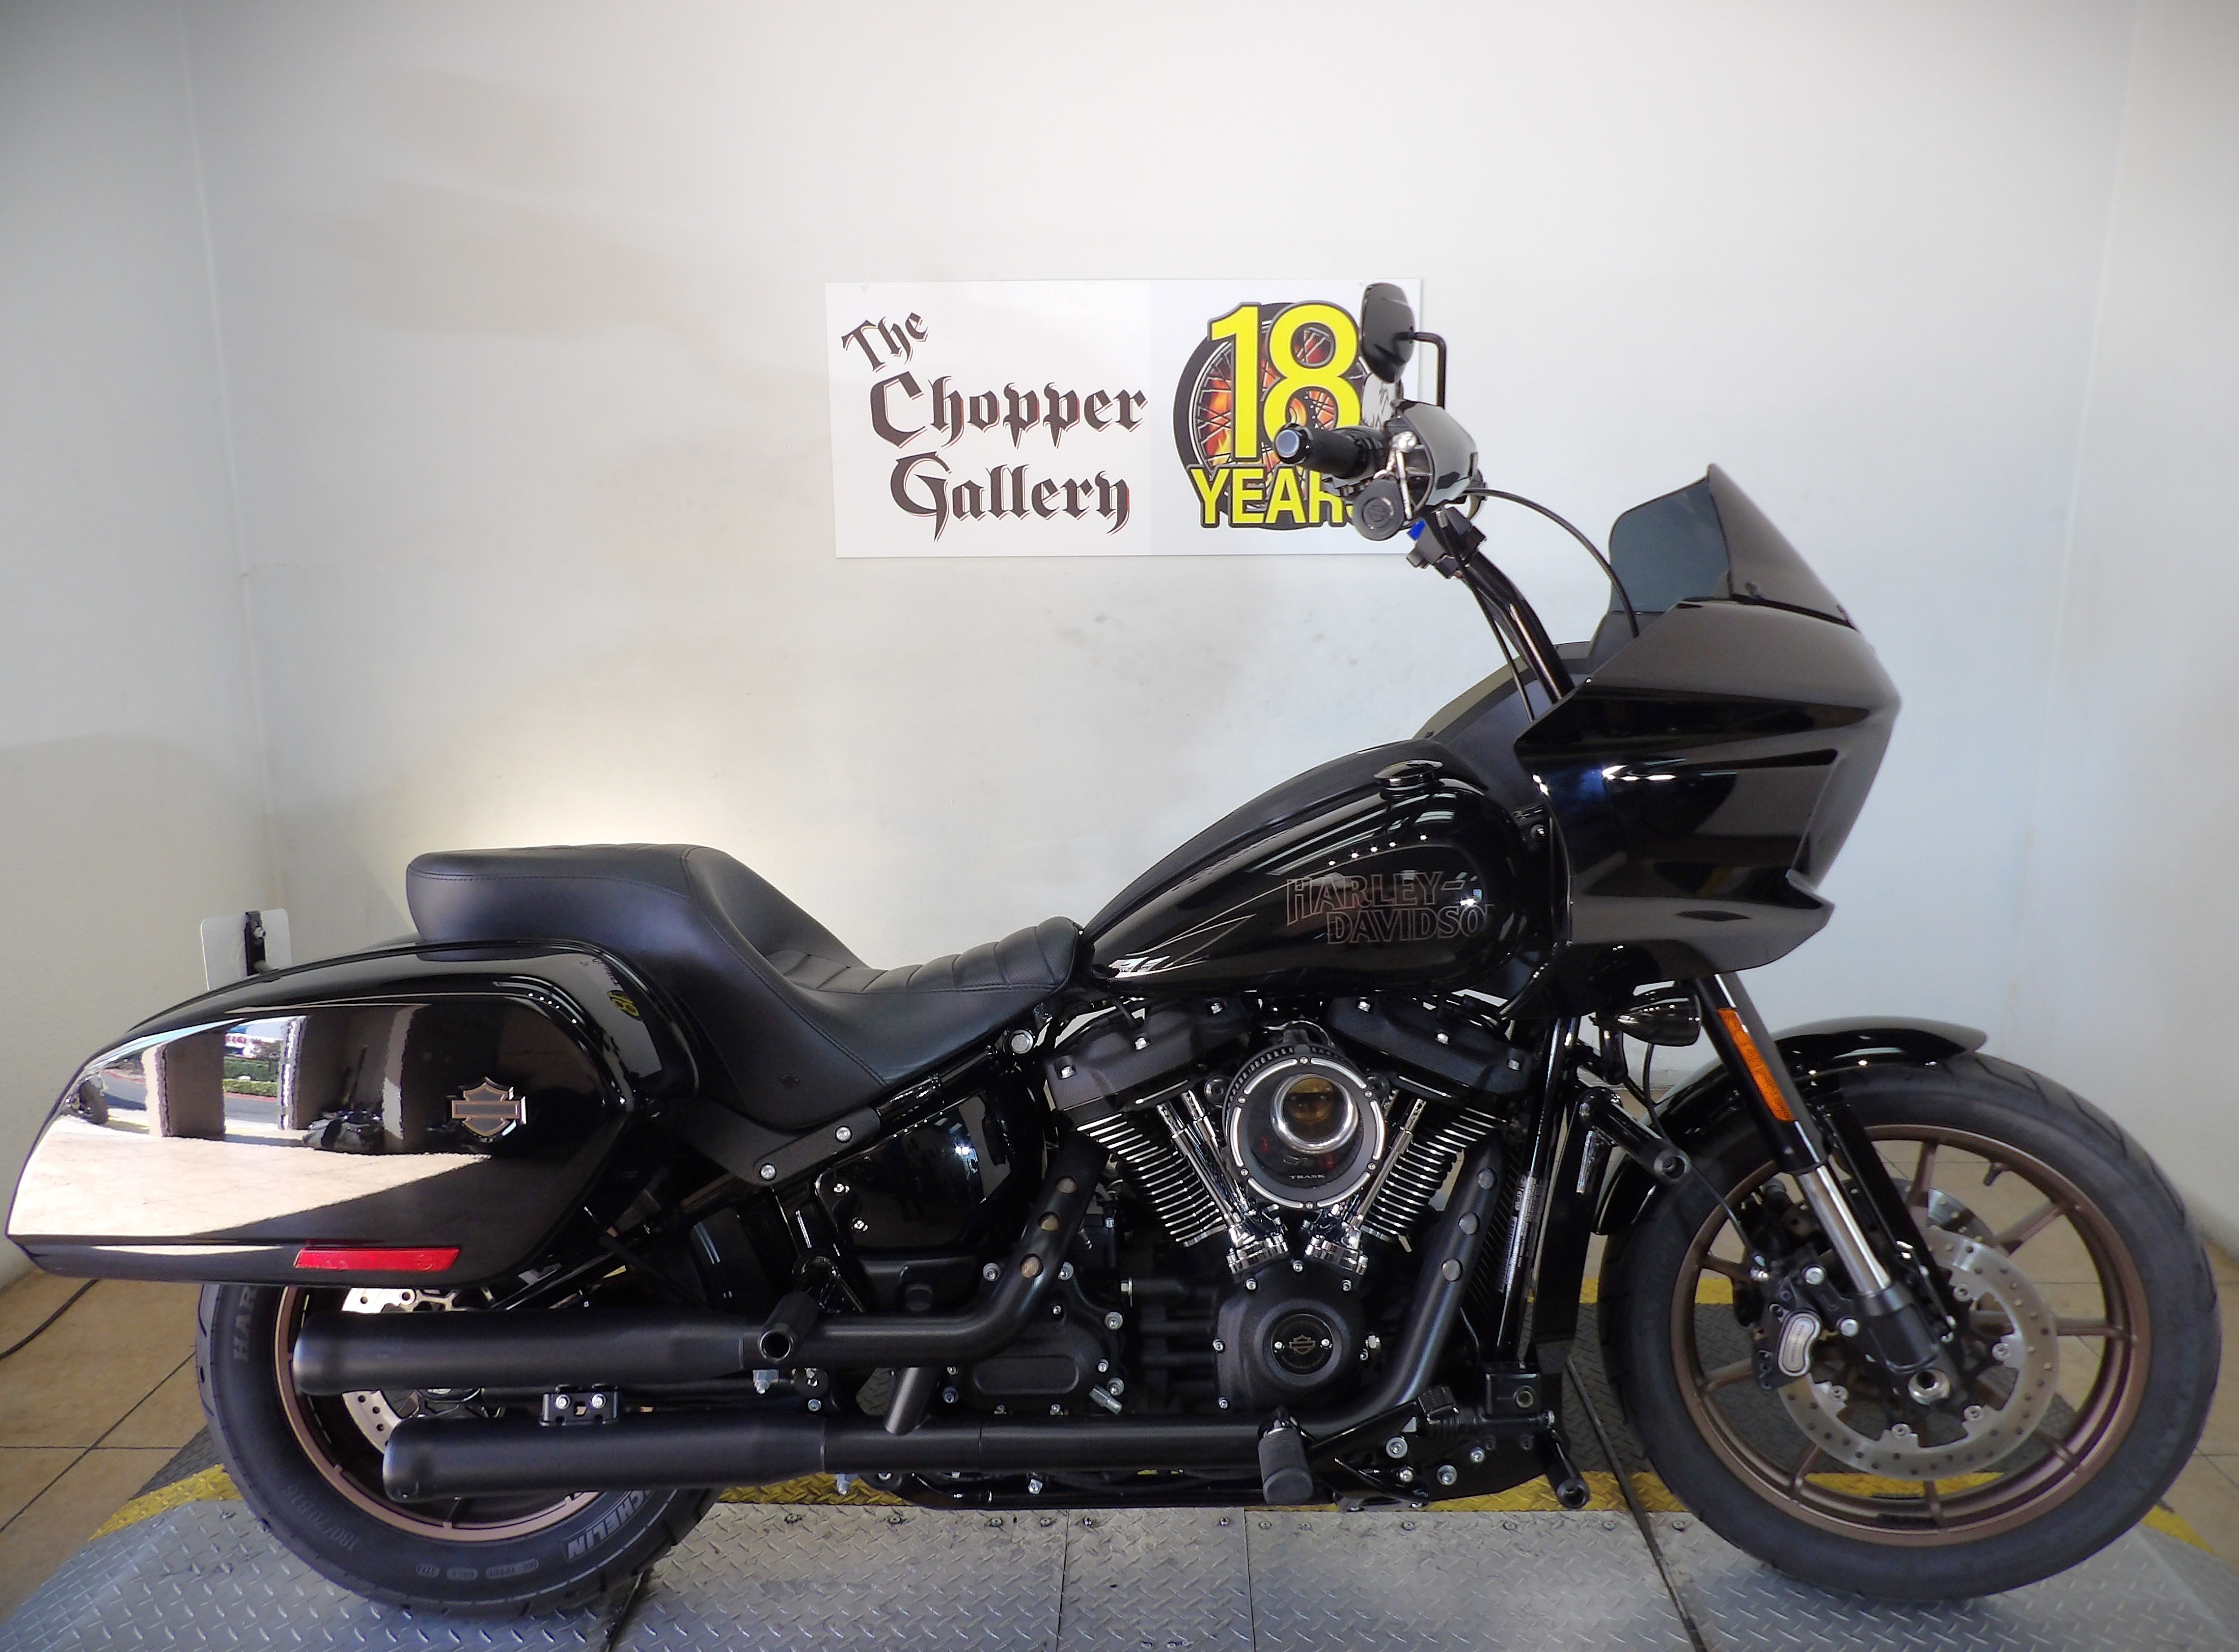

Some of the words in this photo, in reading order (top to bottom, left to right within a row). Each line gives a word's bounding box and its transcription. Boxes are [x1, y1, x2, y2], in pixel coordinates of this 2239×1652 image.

[840, 311, 929, 374] The
[870, 371, 1148, 449] Chopper
[1209, 303, 1362, 460] 18
[890, 451, 1131, 542] Gallery
[1189, 465, 1355, 526] YEAR
[1286, 871, 1465, 927] HARLEY-
[1327, 904, 1495, 944] DAVIDSO
